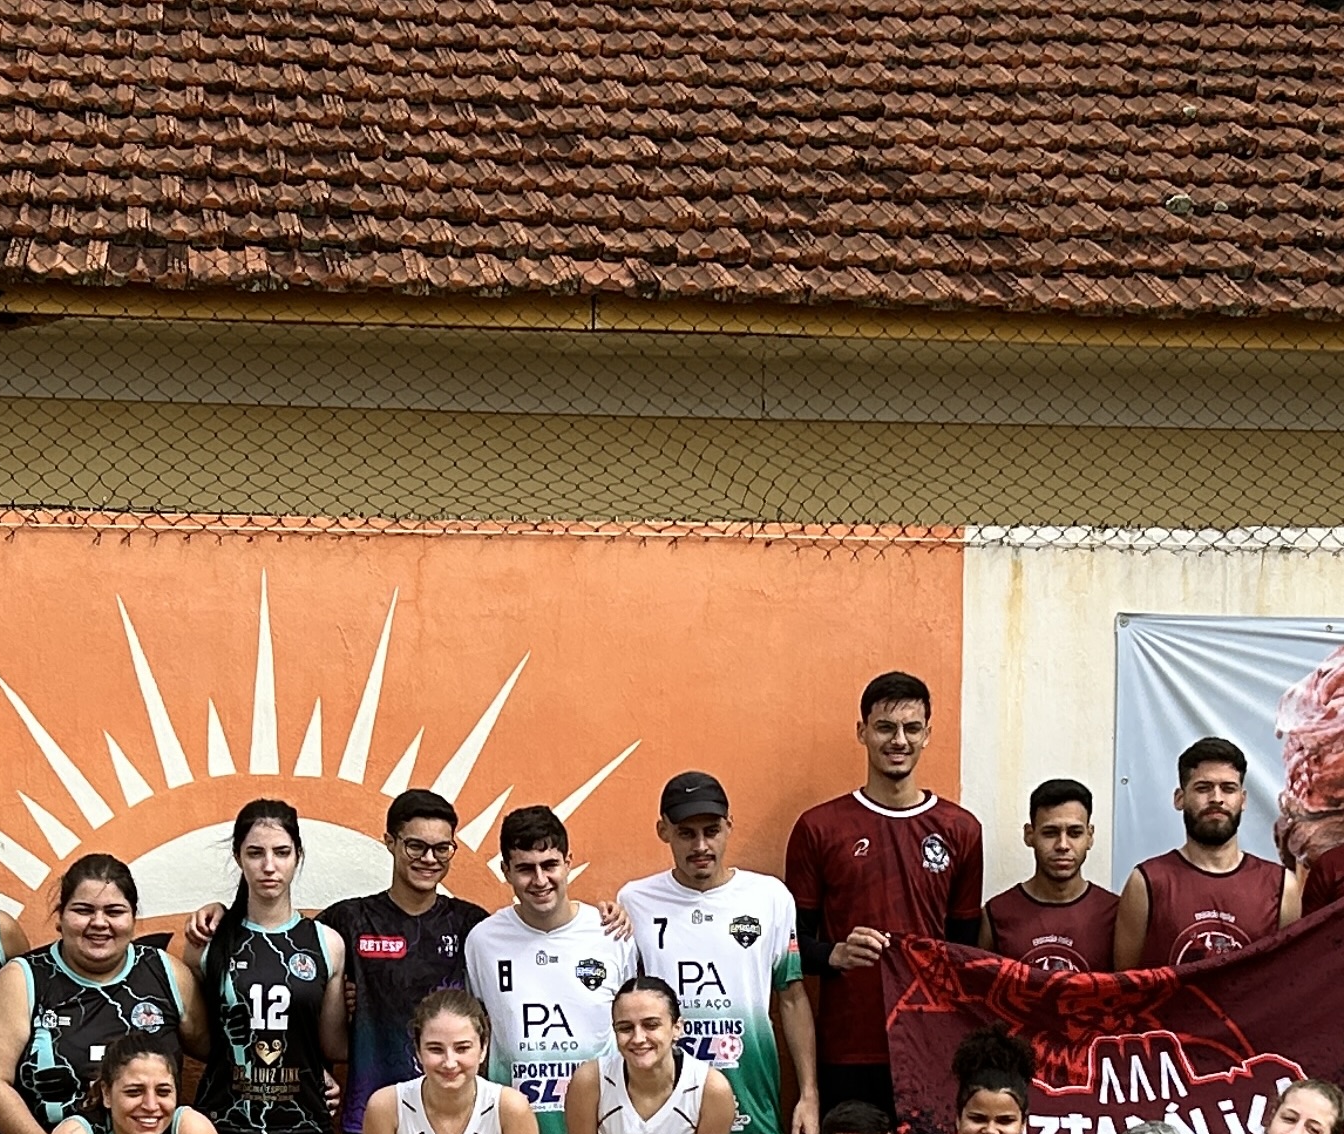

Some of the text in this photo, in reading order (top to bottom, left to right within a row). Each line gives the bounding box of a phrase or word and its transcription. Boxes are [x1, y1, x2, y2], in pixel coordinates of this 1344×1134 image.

[653, 917, 668, 949] 7
[497, 960, 513, 992] 8
[677, 961, 727, 995] PA
[249, 983, 292, 1030] 12
[522, 1003, 574, 1038] PA
[683, 1020, 742, 1035] ORTLINS
[513, 1062, 586, 1079] SPORTLIN
